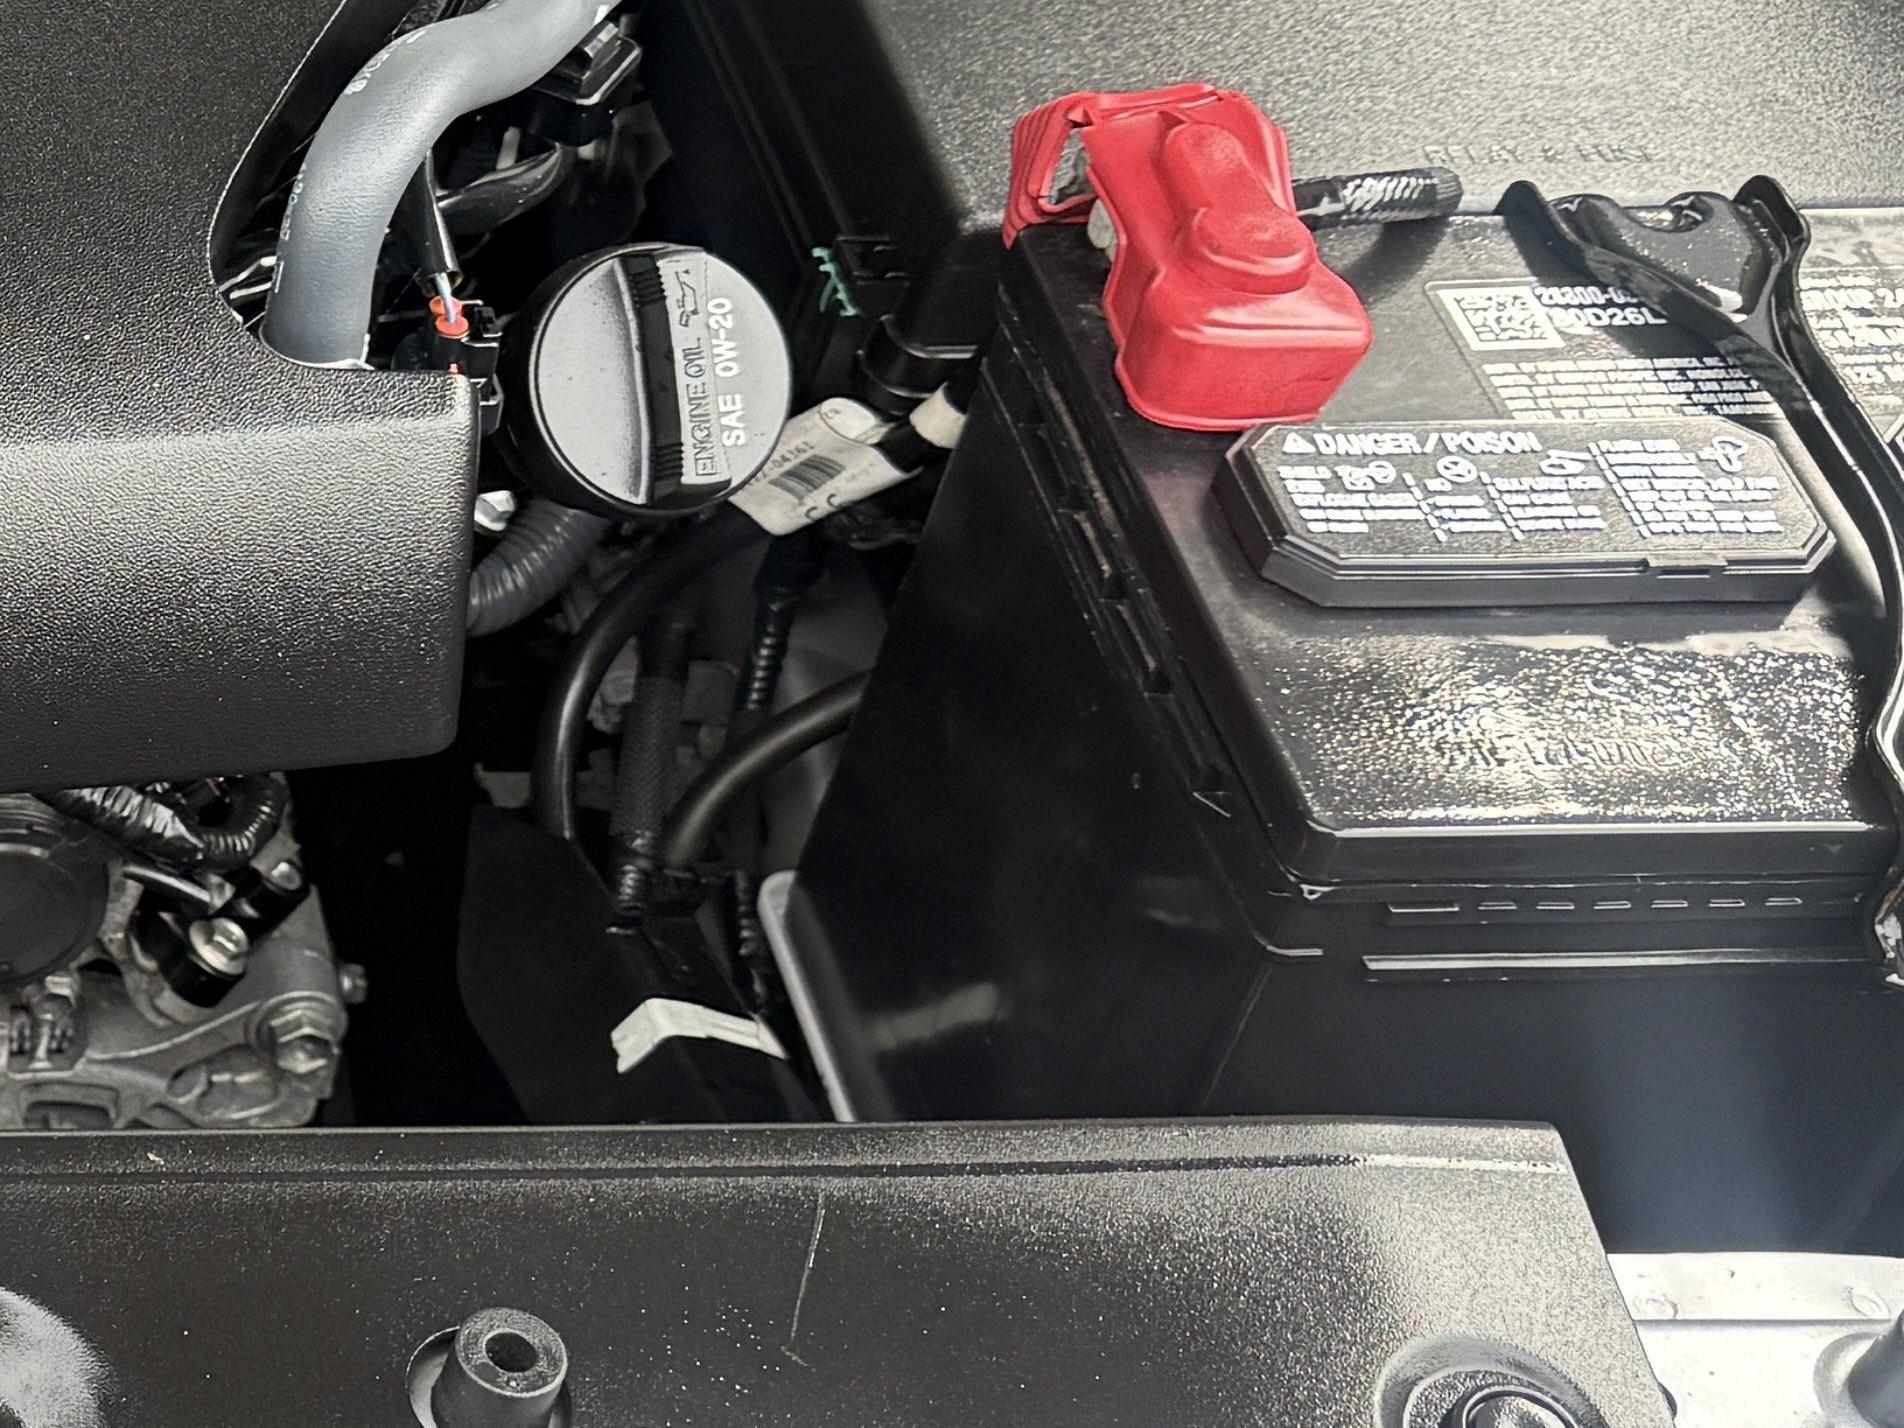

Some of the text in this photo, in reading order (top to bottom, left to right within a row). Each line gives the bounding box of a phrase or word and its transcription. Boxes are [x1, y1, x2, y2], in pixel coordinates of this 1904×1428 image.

[682, 336, 717, 477] ENGINE OIL
[707, 296, 747, 448] SAE 0W-20
[1313, 432, 1423, 455] DANGER
[1439, 431, 1543, 455] POISON
